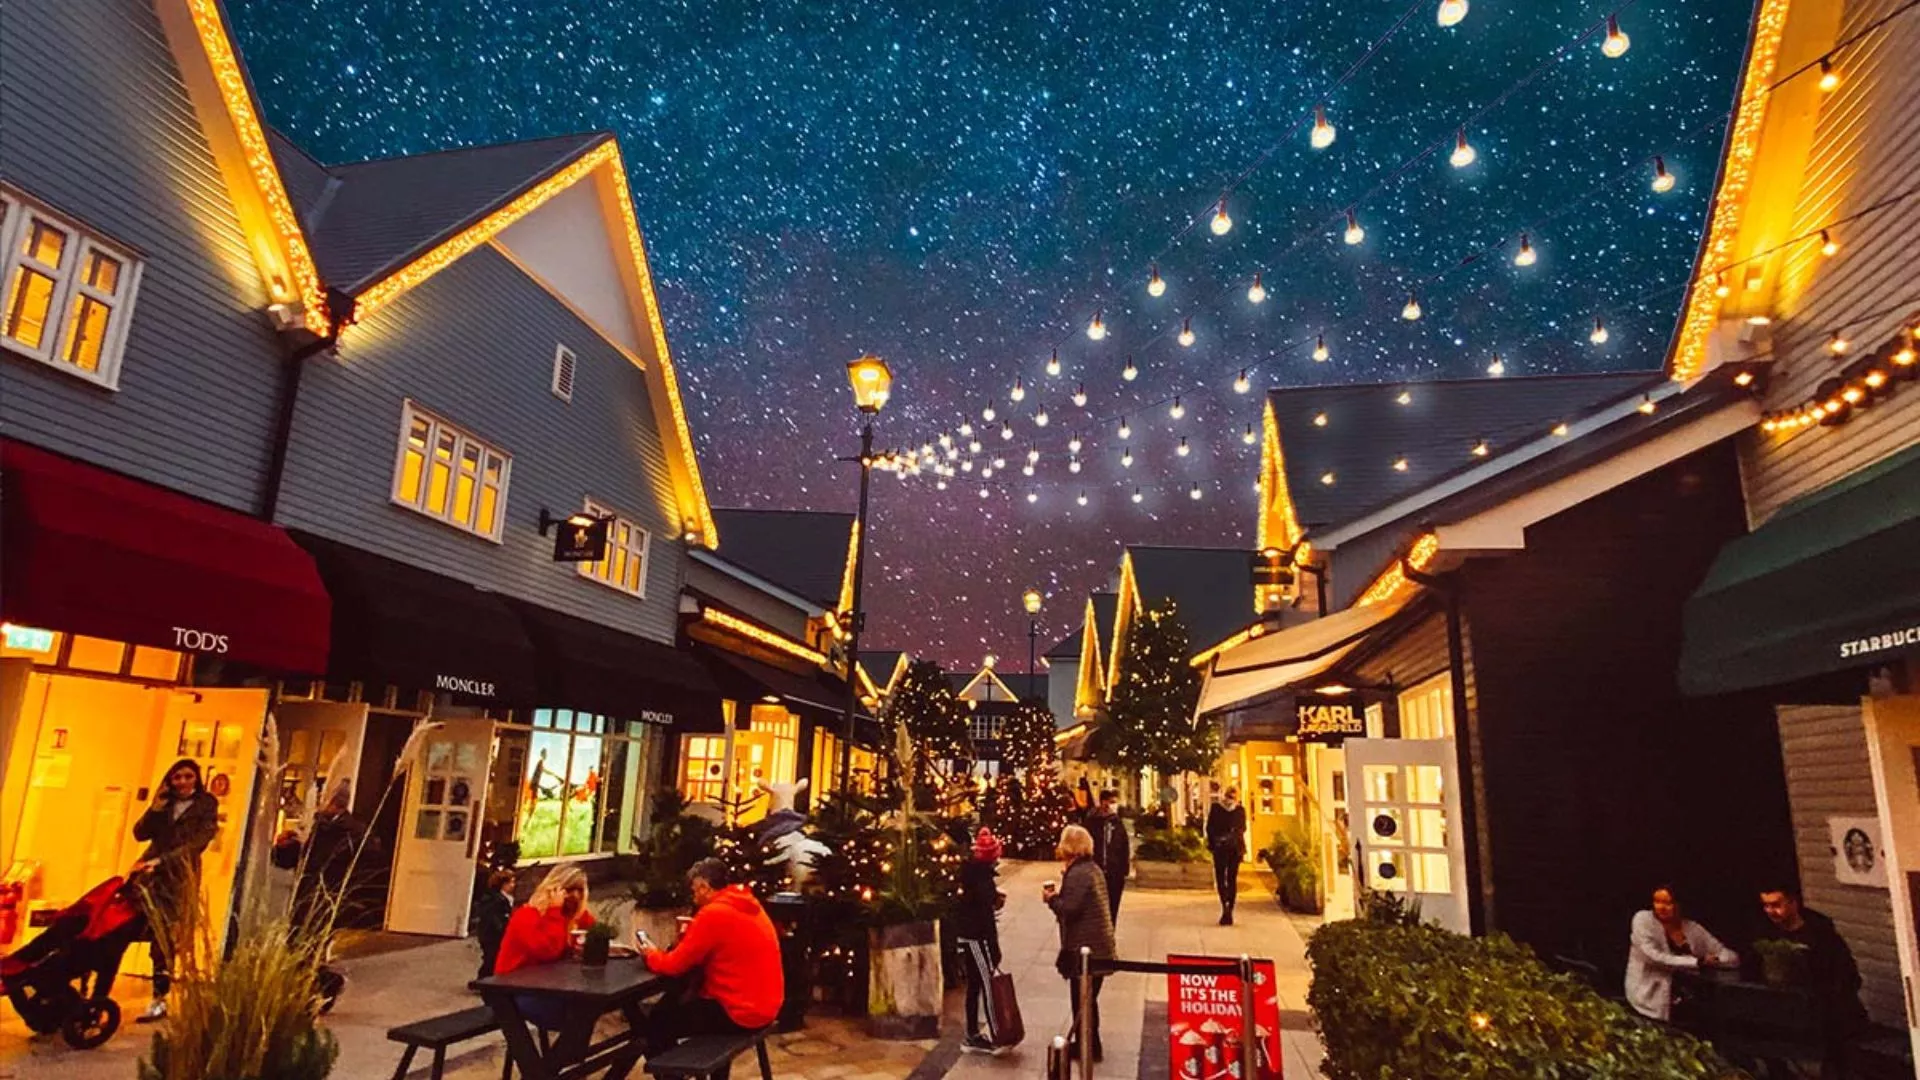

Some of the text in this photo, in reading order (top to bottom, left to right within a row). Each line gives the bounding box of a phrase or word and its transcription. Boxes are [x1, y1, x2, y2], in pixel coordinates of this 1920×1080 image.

[172, 626, 229, 654] TOD'S
[436, 674, 496, 697] MONCLER
[1299, 705, 1362, 725] KARL
[1180, 973, 1218, 987] NOW
[1180, 987, 1238, 1002] IT'S THE
